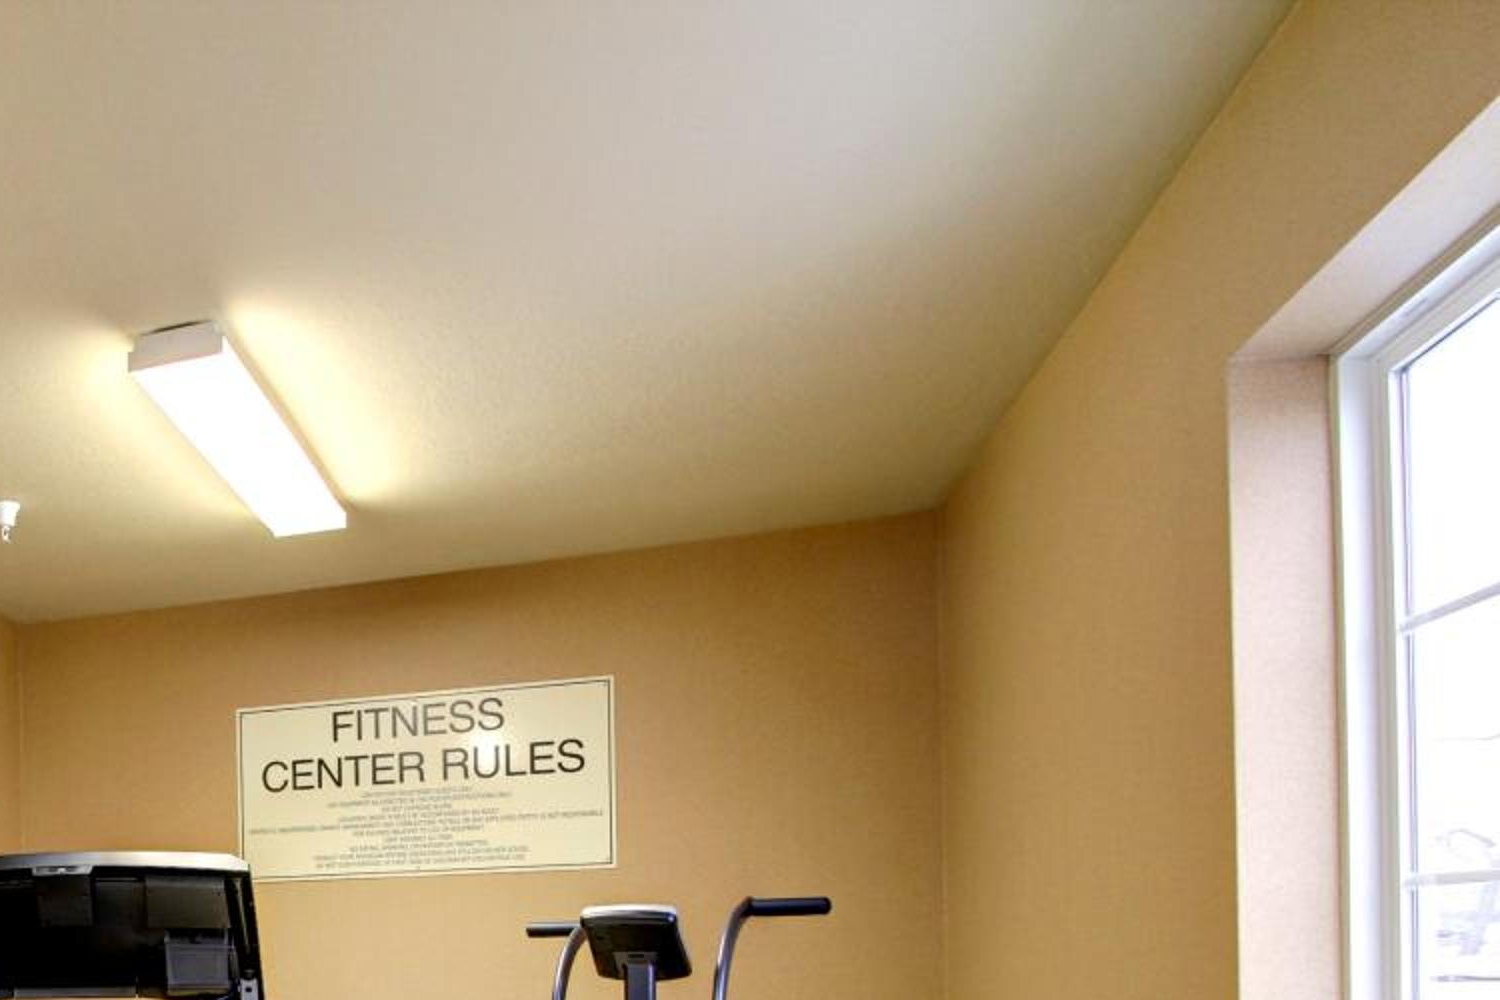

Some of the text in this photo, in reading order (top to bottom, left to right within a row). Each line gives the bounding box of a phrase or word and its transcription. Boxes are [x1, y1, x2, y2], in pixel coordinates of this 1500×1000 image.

[332, 698, 505, 742] FITNESS
[261, 738, 586, 793] CENTER RULES
